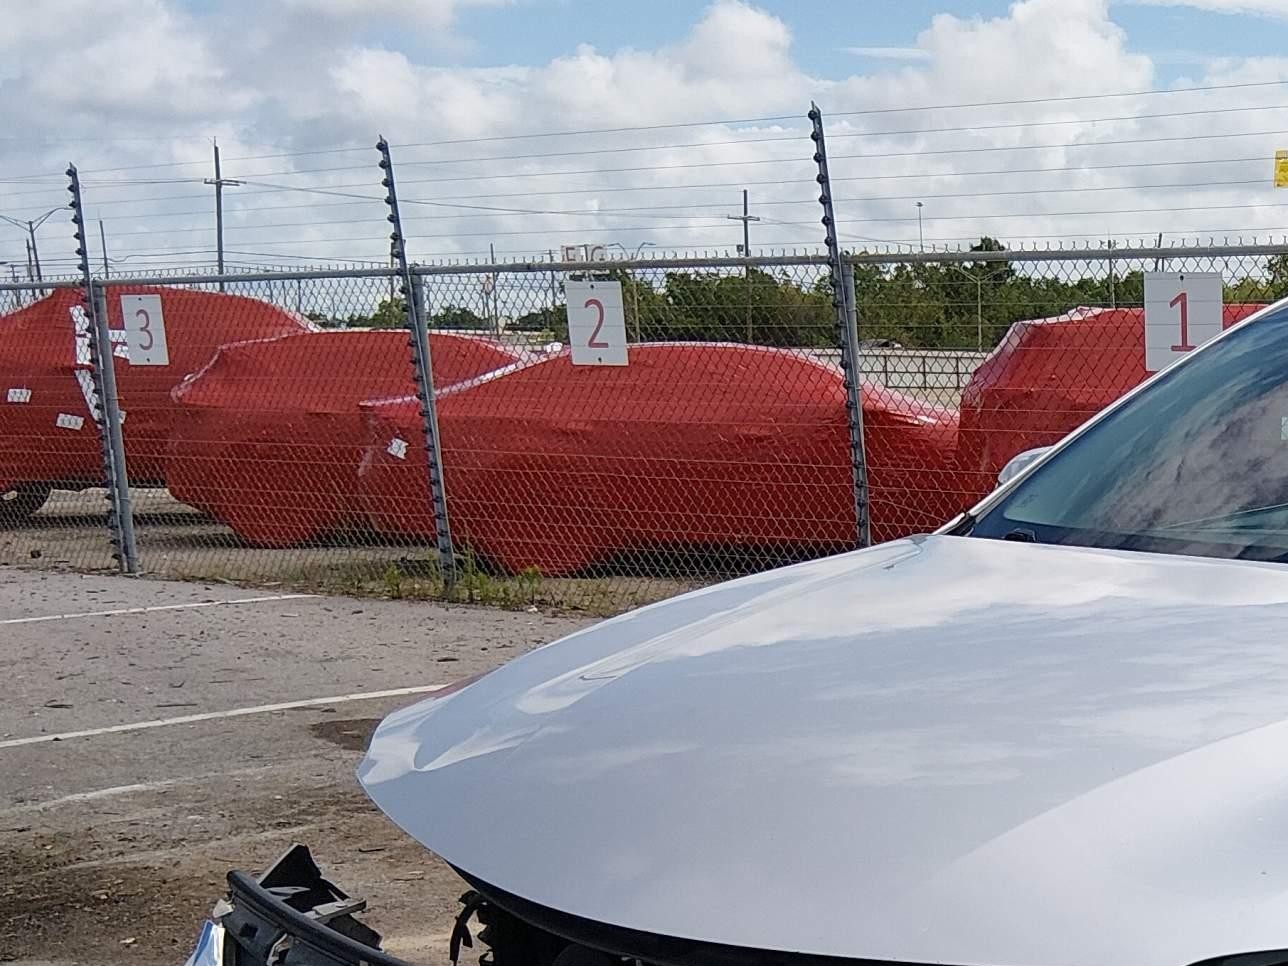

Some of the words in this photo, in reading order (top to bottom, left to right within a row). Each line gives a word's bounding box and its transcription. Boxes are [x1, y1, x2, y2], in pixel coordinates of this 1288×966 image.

[135, 308, 154, 351] 3
[584, 298, 609, 349] 2
[1169, 291, 1198, 352] 1
